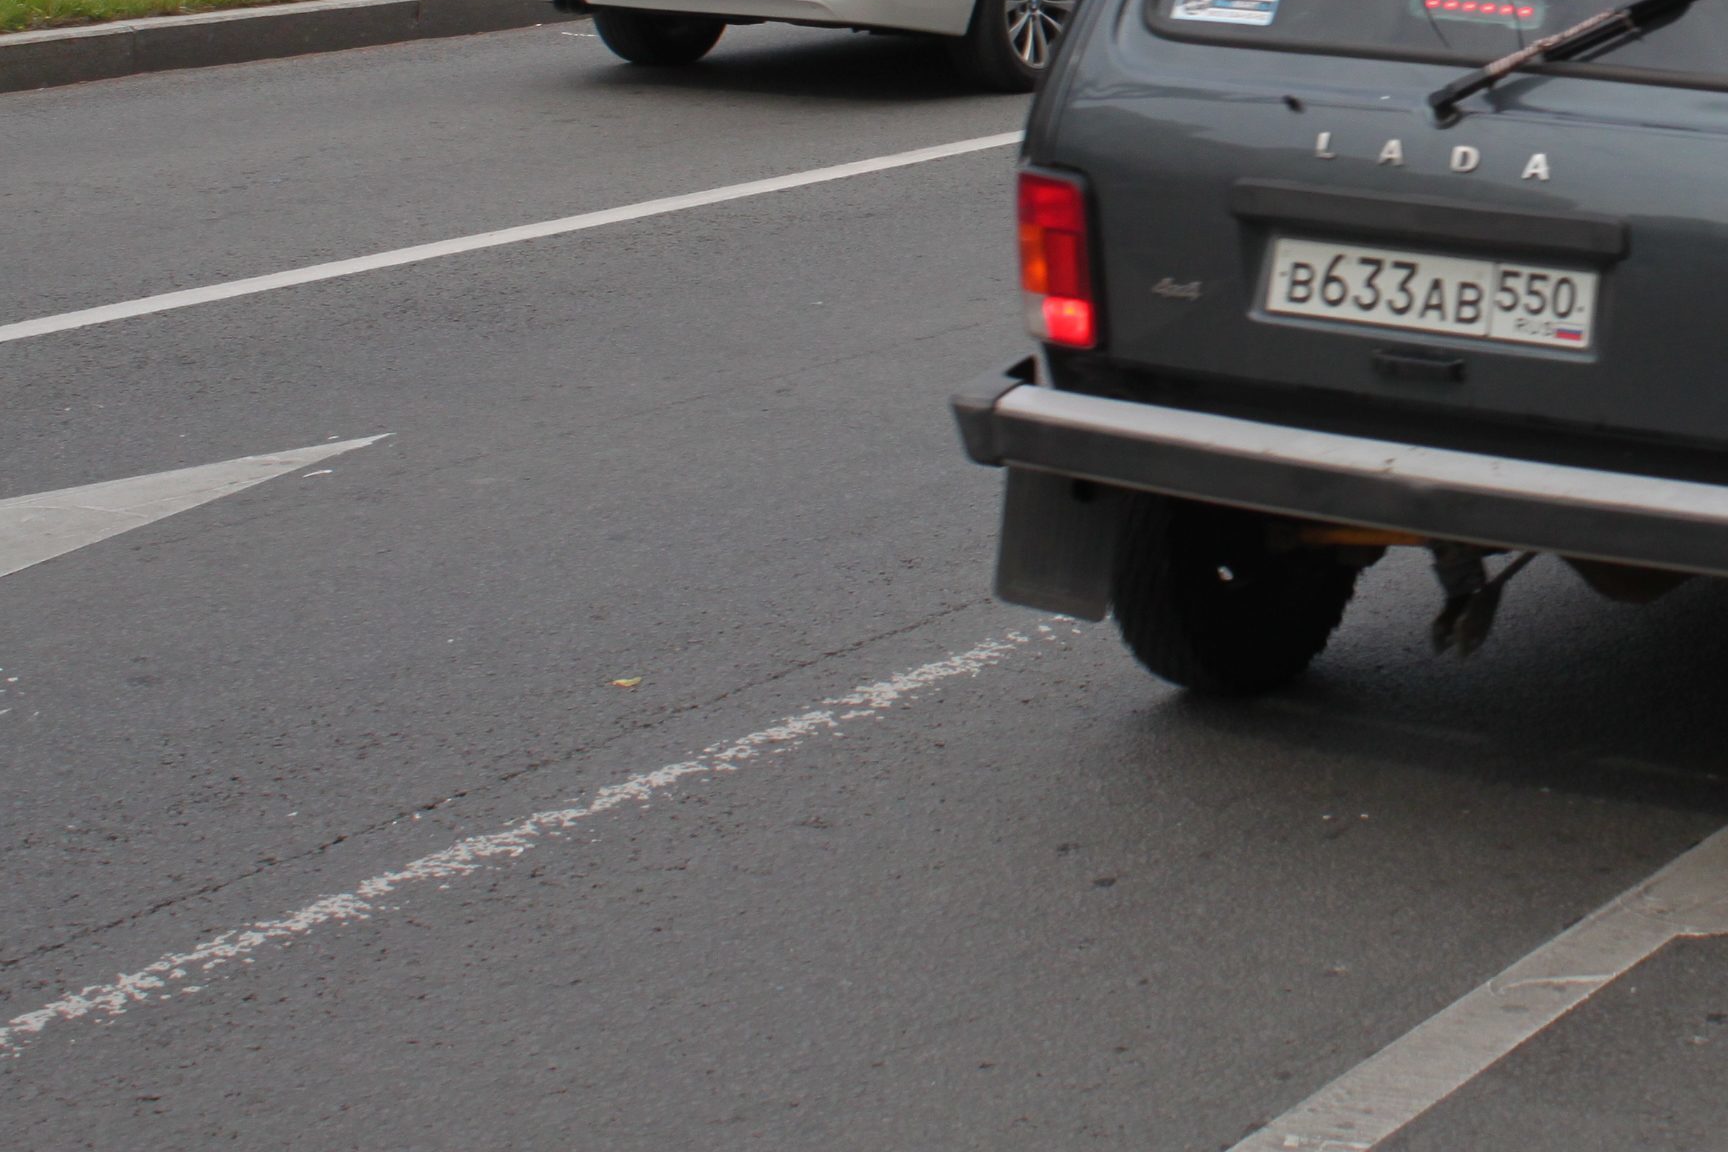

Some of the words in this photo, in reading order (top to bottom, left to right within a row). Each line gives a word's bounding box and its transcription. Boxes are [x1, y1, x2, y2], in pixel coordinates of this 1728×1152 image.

[1315, 131, 1551, 181] LADA
[1287, 254, 1484, 325] В633АВ
[1495, 270, 1577, 319] 550
